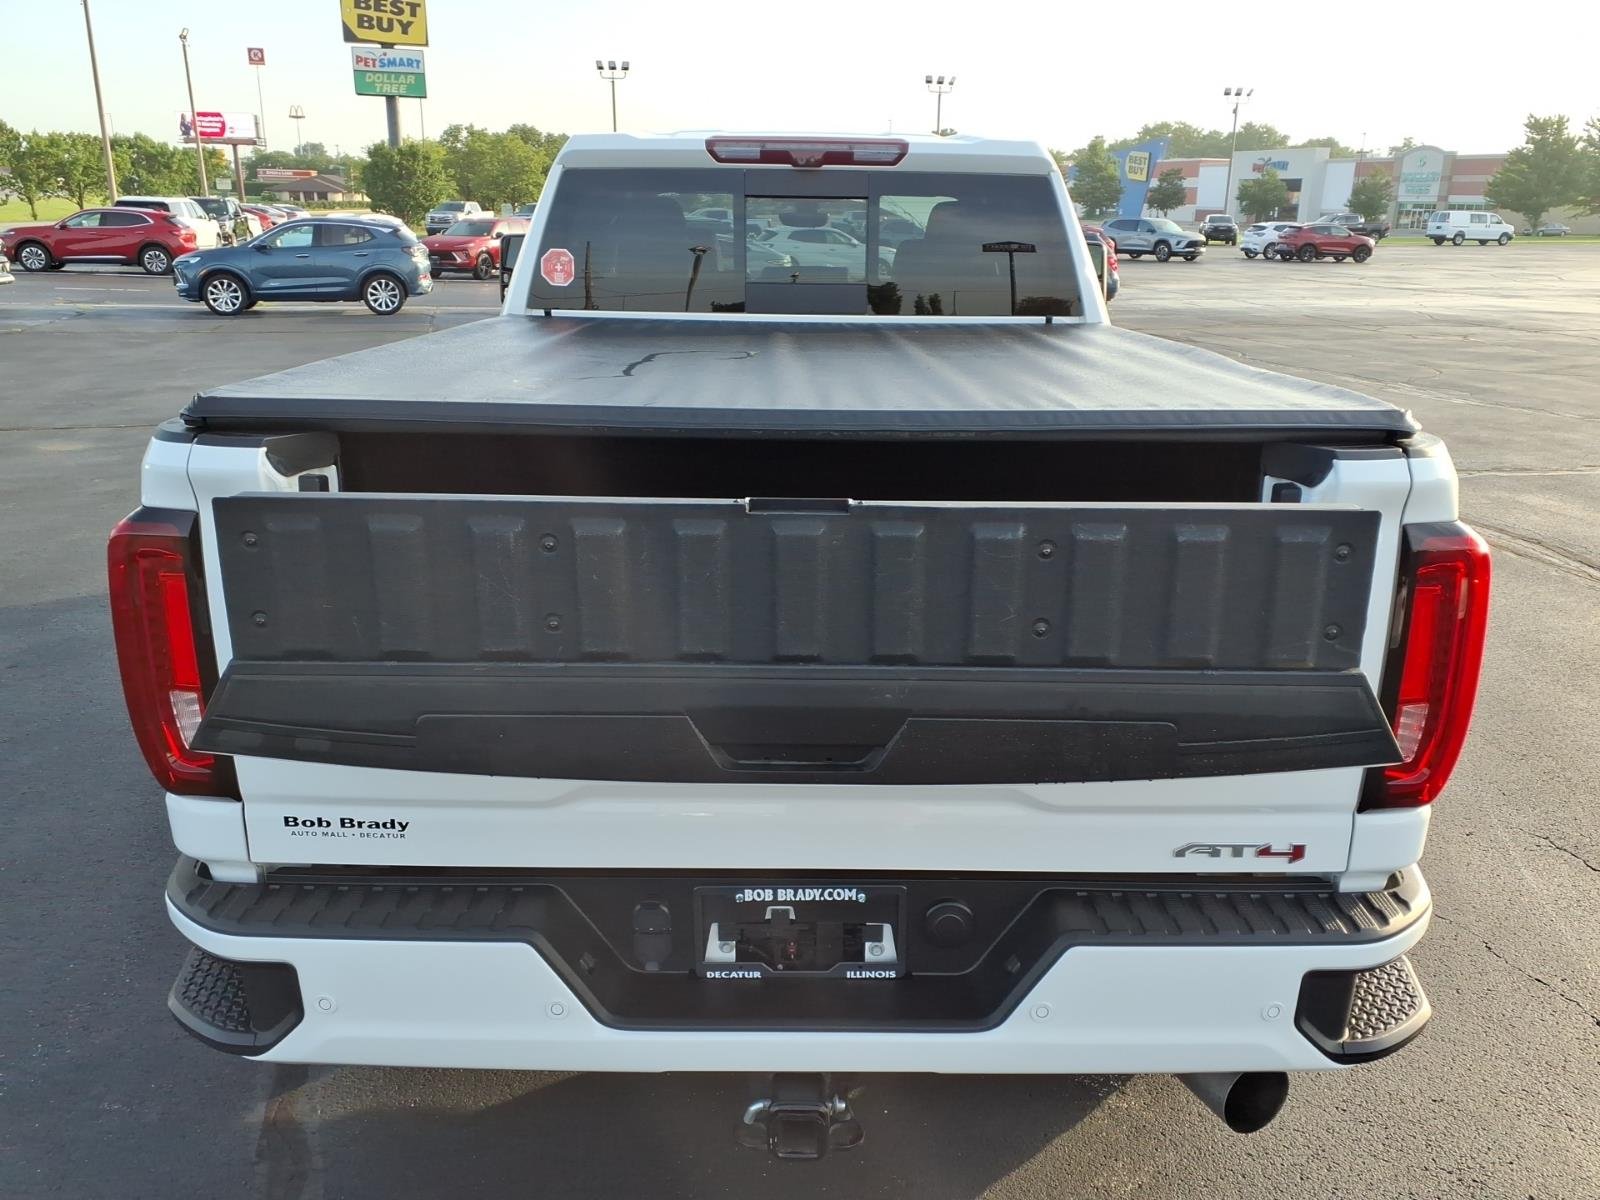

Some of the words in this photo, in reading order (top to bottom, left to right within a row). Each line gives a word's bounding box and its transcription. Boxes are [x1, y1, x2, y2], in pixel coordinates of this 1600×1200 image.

[353, 0, 421, 18] BEST
[356, 13, 414, 36] BUY
[355, 55, 421, 69] PETSMART
[365, 73, 416, 84] DOLLAR
[375, 83, 408, 94] TREE
[1128, 154, 1148, 166] BEST
[1128, 165, 1145, 176] BUY
[283, 816, 332, 829] Bob
[339, 817, 410, 832] Brady
[359, 832, 406, 840] DECATUR
[1172, 842, 1307, 864] AT4
[744, 889, 774, 902] BOB
[777, 888, 857, 901] BRADY.COM
[706, 971, 762, 979] DECATUR
[846, 970, 897, 979] ILLINOIS
